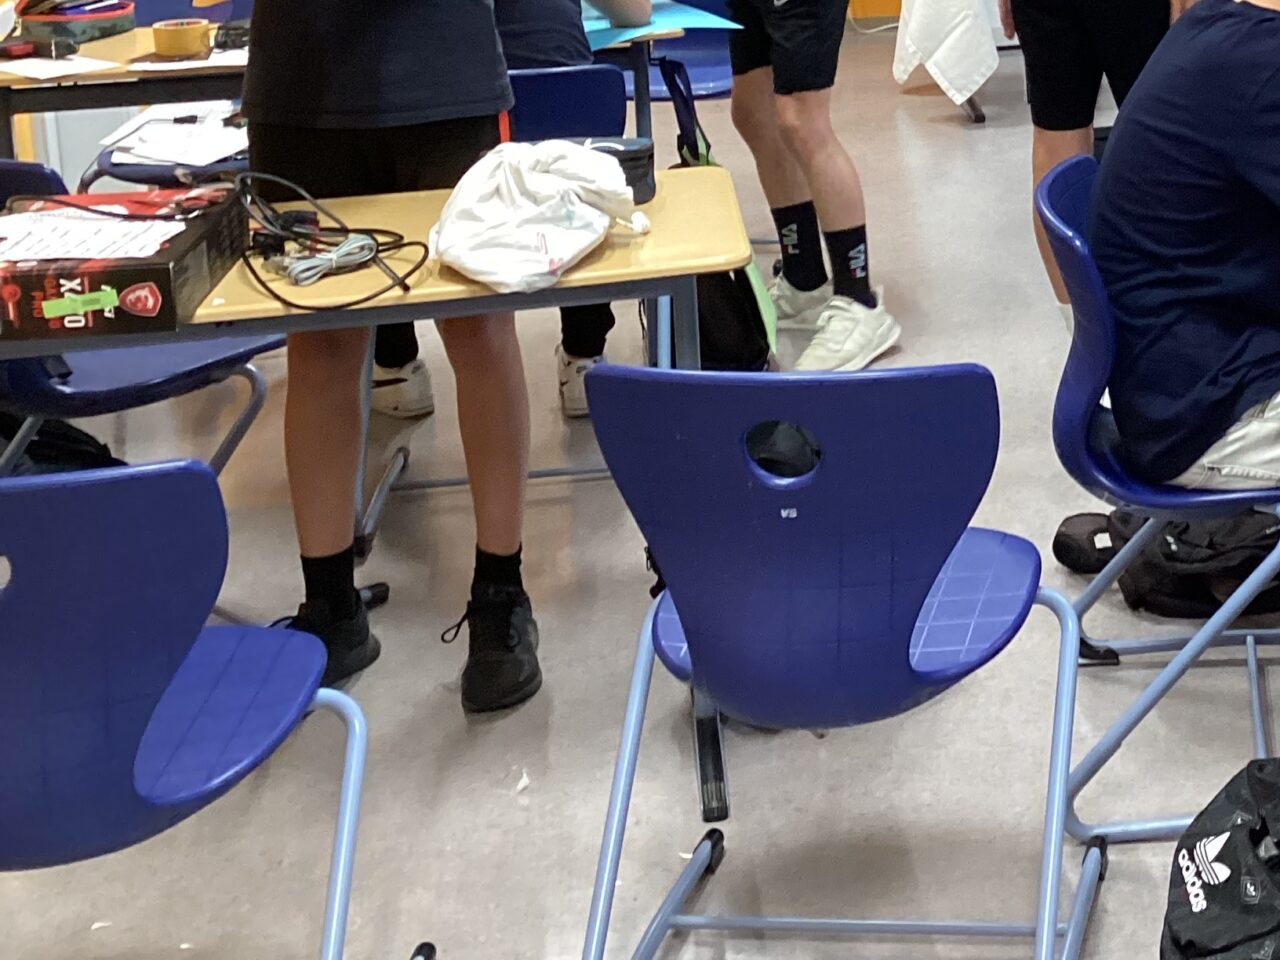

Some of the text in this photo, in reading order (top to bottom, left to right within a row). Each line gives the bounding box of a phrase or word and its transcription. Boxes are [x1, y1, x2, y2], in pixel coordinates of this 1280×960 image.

[848, 243, 867, 279] FILA
[59, 278, 86, 328] X0
[1178, 848, 1207, 913] adidas
